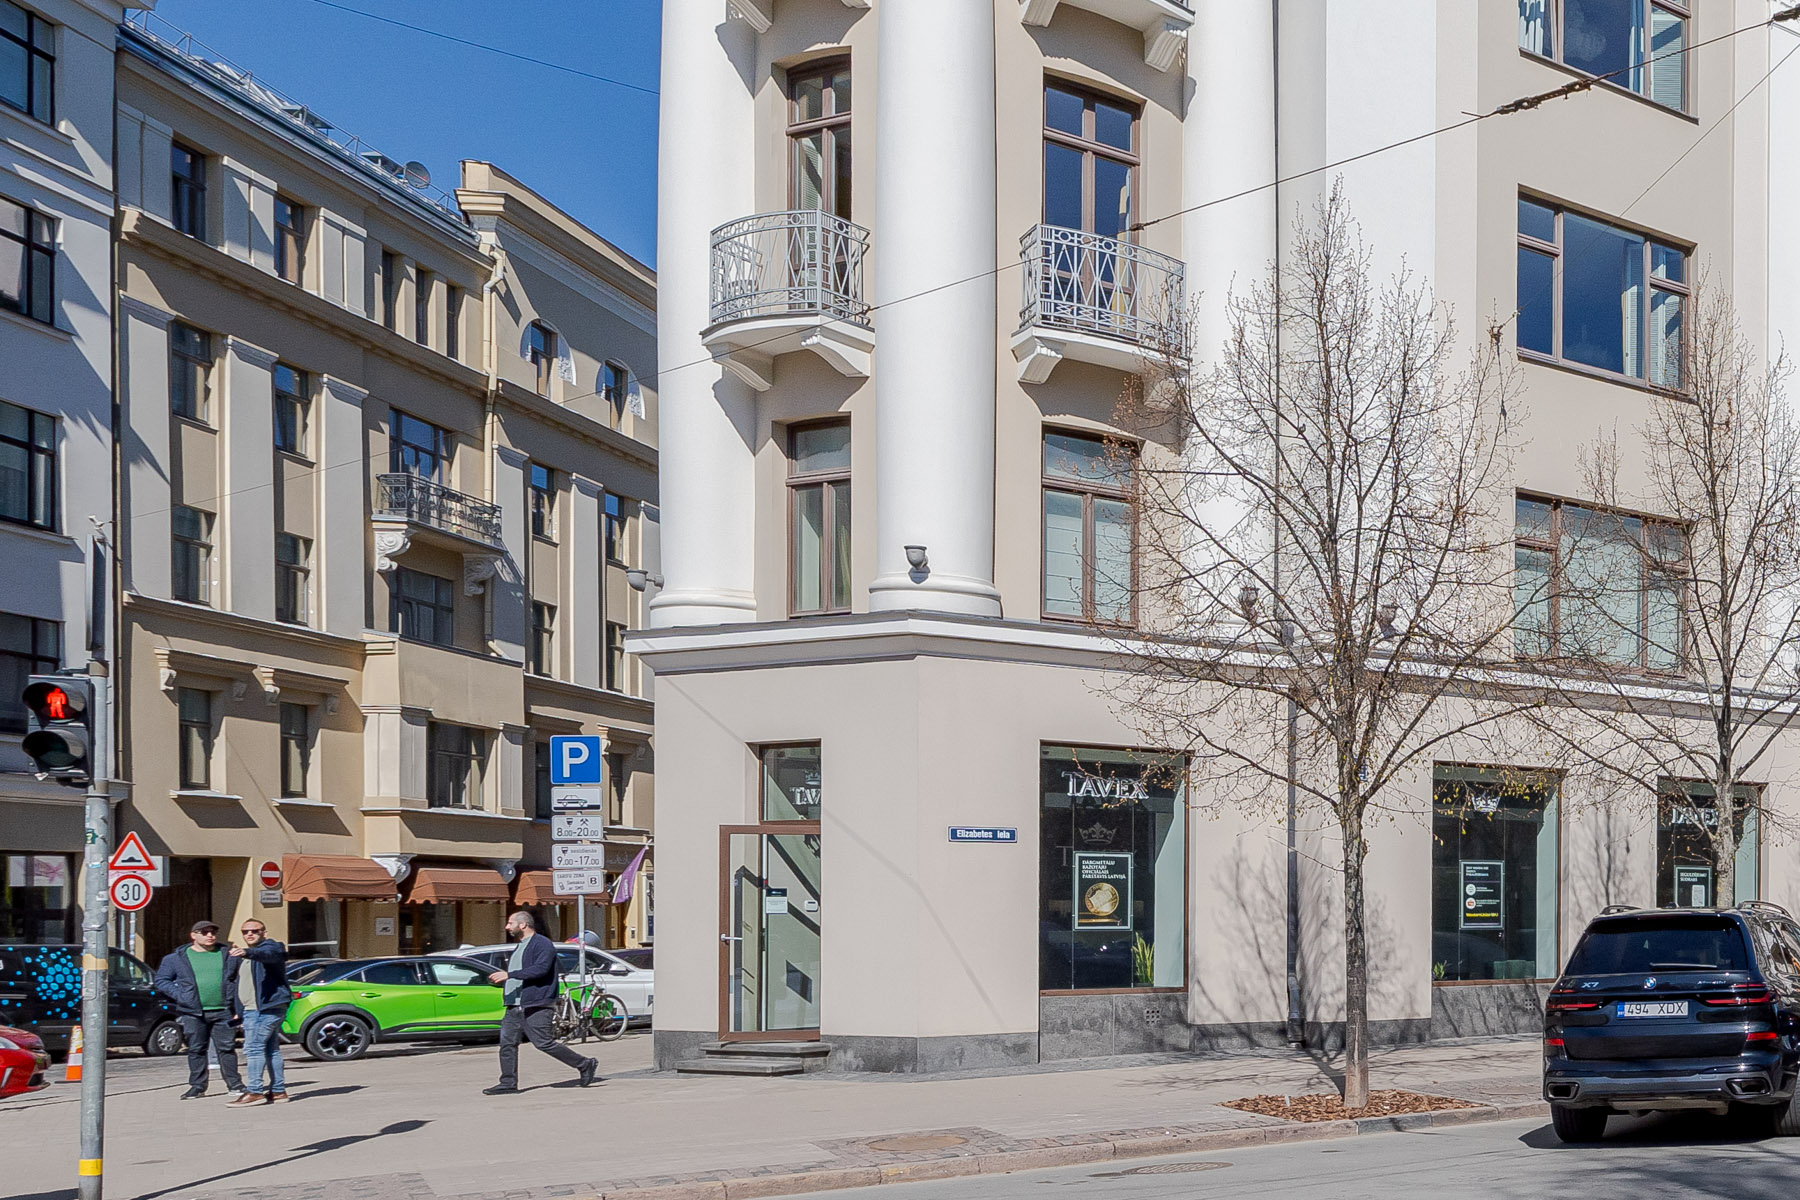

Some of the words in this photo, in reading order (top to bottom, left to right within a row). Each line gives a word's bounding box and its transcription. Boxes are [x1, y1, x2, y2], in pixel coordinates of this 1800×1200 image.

[562, 741, 590, 778] P
[1061, 771, 1149, 799] TAVEX
[956, 829, 993, 838] Elizabetes
[590, 877, 597, 885] B
[121, 883, 140, 901] 30
[1627, 1003, 1649, 1015] 494
[1658, 1002, 1684, 1014] XDX
